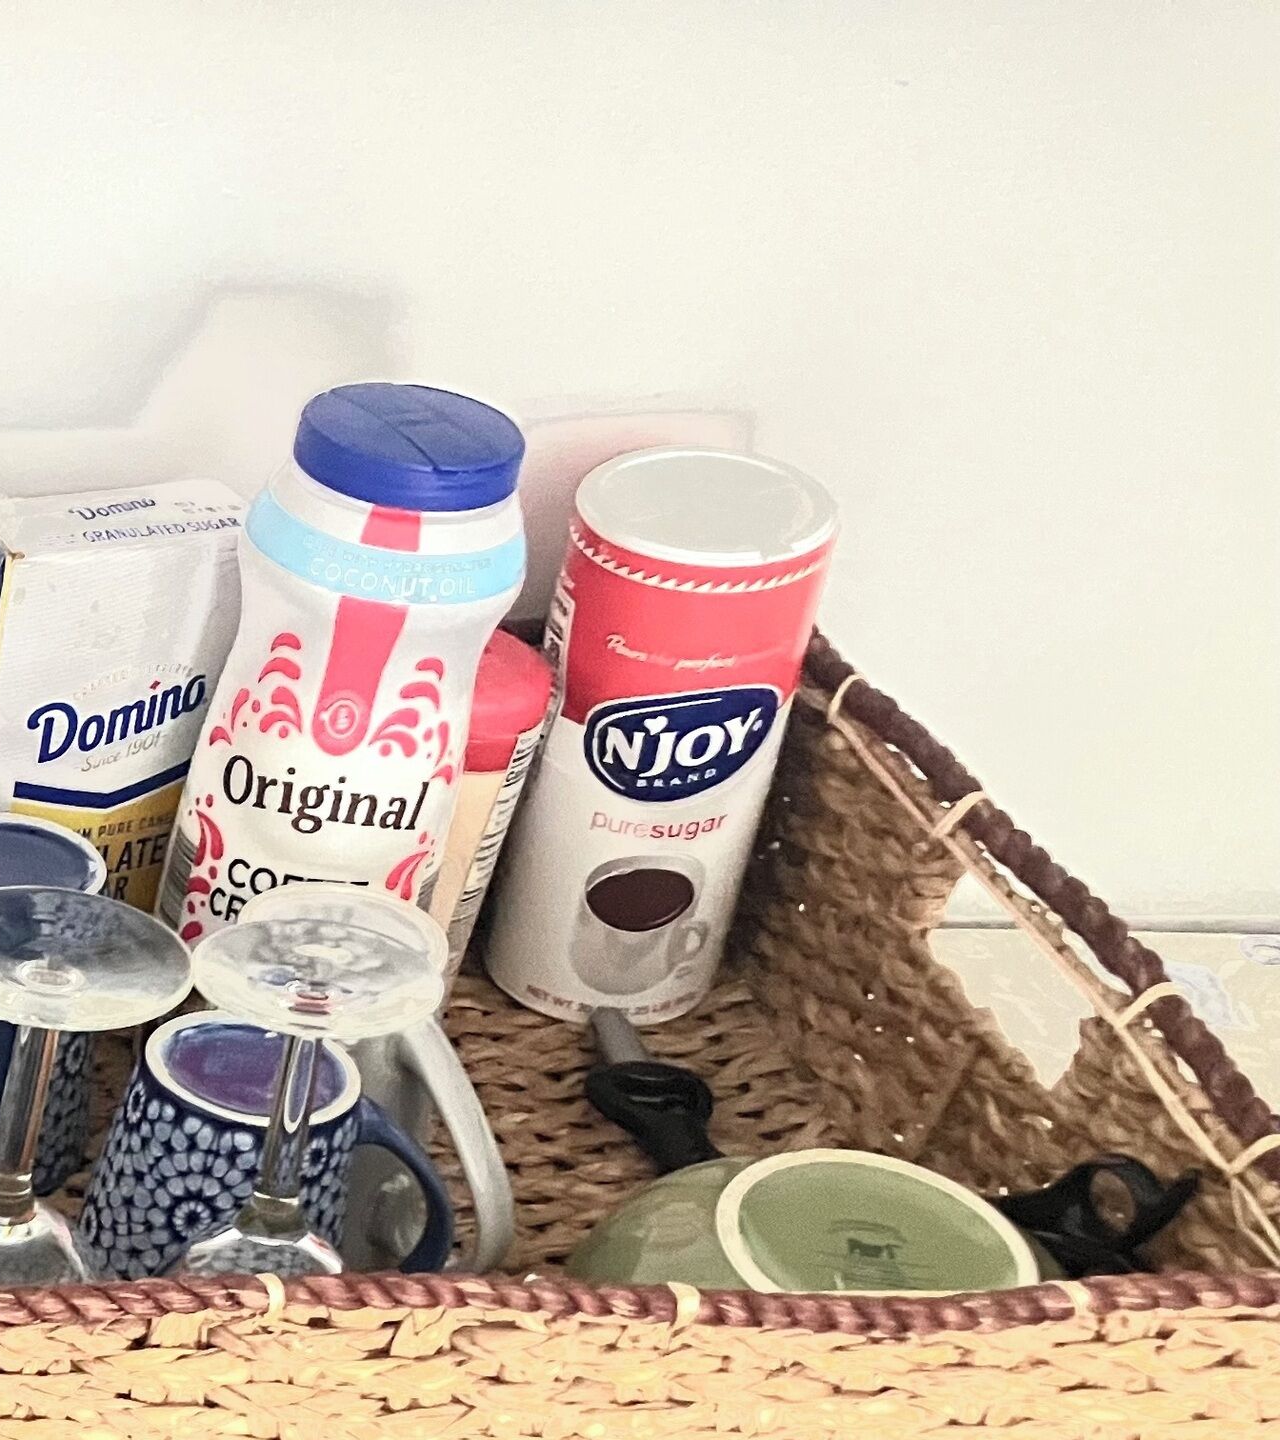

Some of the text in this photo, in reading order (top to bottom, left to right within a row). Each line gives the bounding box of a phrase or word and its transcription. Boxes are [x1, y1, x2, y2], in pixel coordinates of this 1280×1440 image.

[68, 497, 156, 521] Domino
[82, 523, 186, 543] GRANULATED
[187, 517, 241, 533] SUGAR
[309, 557, 476, 597] COCONUT OIL
[26, 674, 207, 764] Domino
[80, 750, 121, 773] Since
[635, 767, 717, 788] BRAND
[222, 754, 430, 835] Original
[97, 819, 133, 838] PURE
